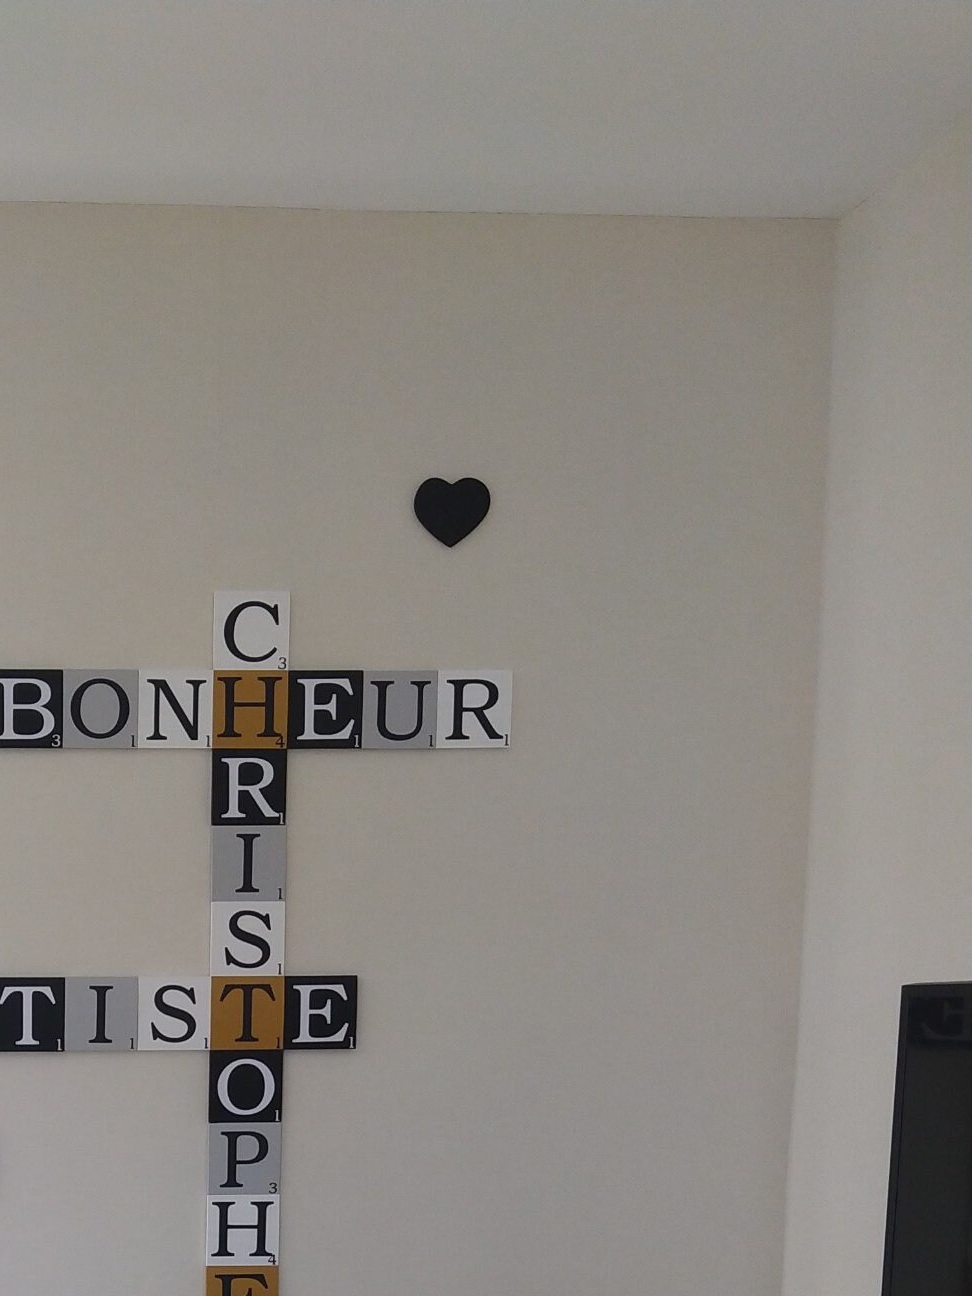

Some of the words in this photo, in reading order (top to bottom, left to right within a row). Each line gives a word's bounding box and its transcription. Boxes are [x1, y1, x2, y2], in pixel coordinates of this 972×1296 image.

[278, 657, 287, 670] 3
[51, 734, 61, 747] 3
[275, 734, 285, 748] 4
[268, 1182, 278, 1194] 3
[268, 1254, 276, 1266] 4
